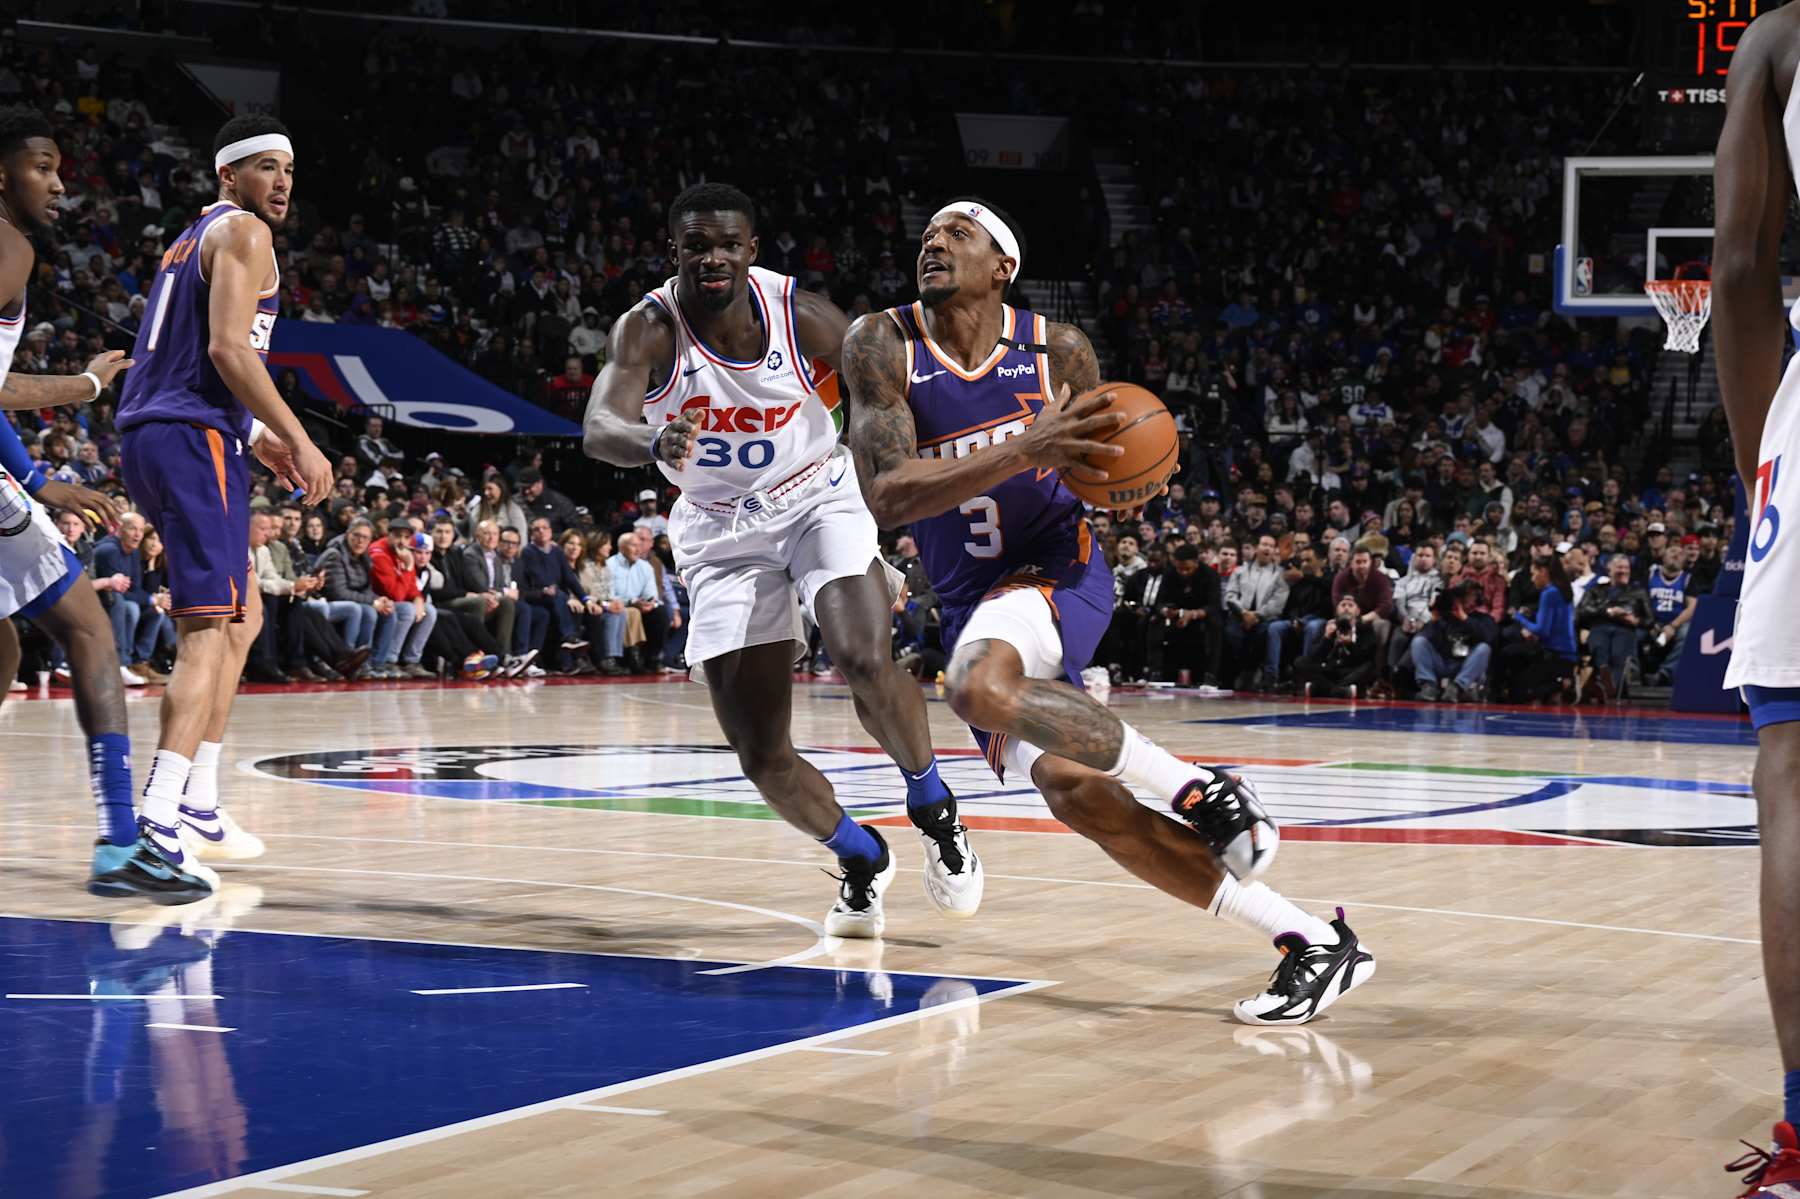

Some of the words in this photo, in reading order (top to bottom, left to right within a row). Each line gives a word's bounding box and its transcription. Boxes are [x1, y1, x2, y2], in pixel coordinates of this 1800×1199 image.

[760, 370, 794, 384] crypto.com
[997, 363, 1036, 379] PayPal
[695, 437, 775, 469] 30
[959, 495, 1006, 560] 3
